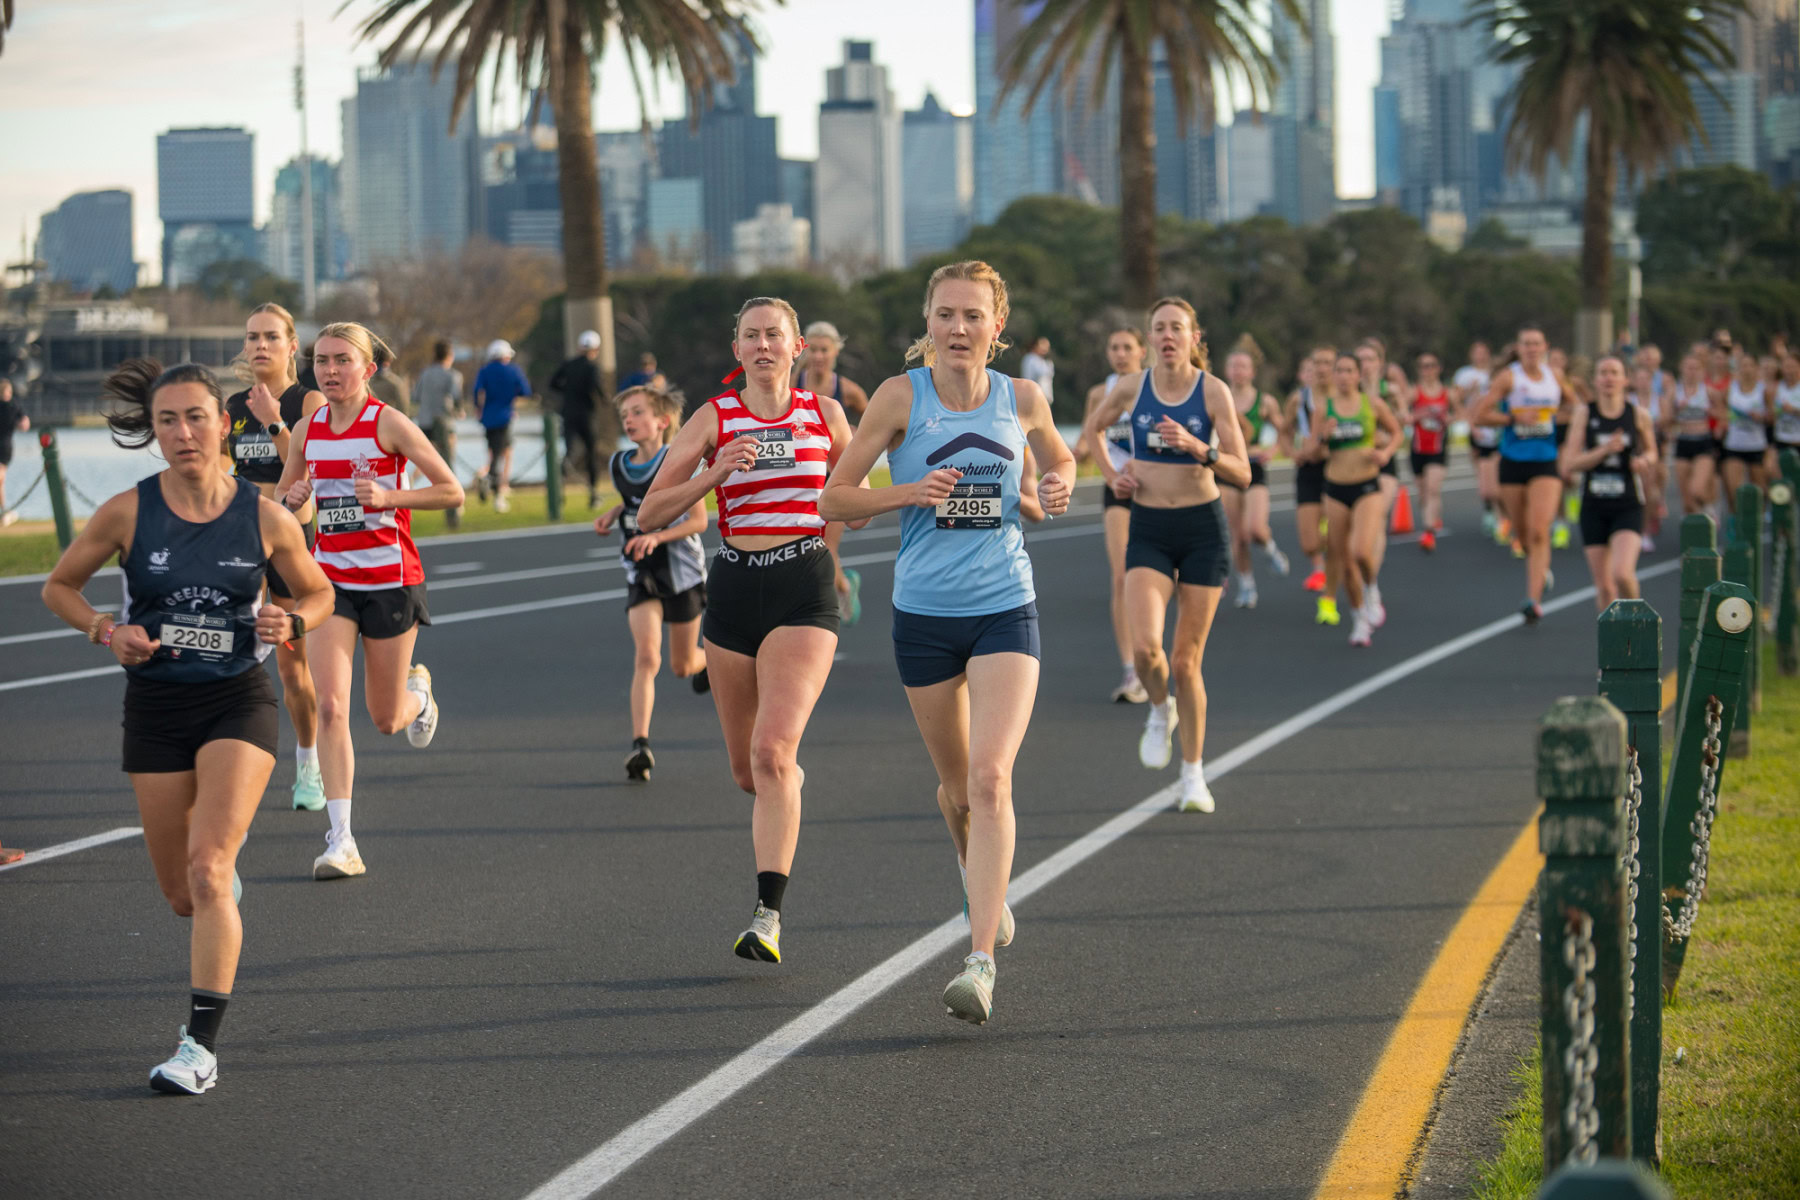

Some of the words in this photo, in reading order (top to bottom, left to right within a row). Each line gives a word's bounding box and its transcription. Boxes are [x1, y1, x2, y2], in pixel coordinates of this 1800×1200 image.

[243, 445, 270, 457] 2150
[751, 443, 786, 458] 243
[947, 500, 991, 516] 2495
[327, 509, 357, 523] 1243
[747, 544, 798, 567] NIKE
[173, 628, 223, 650] 2208
